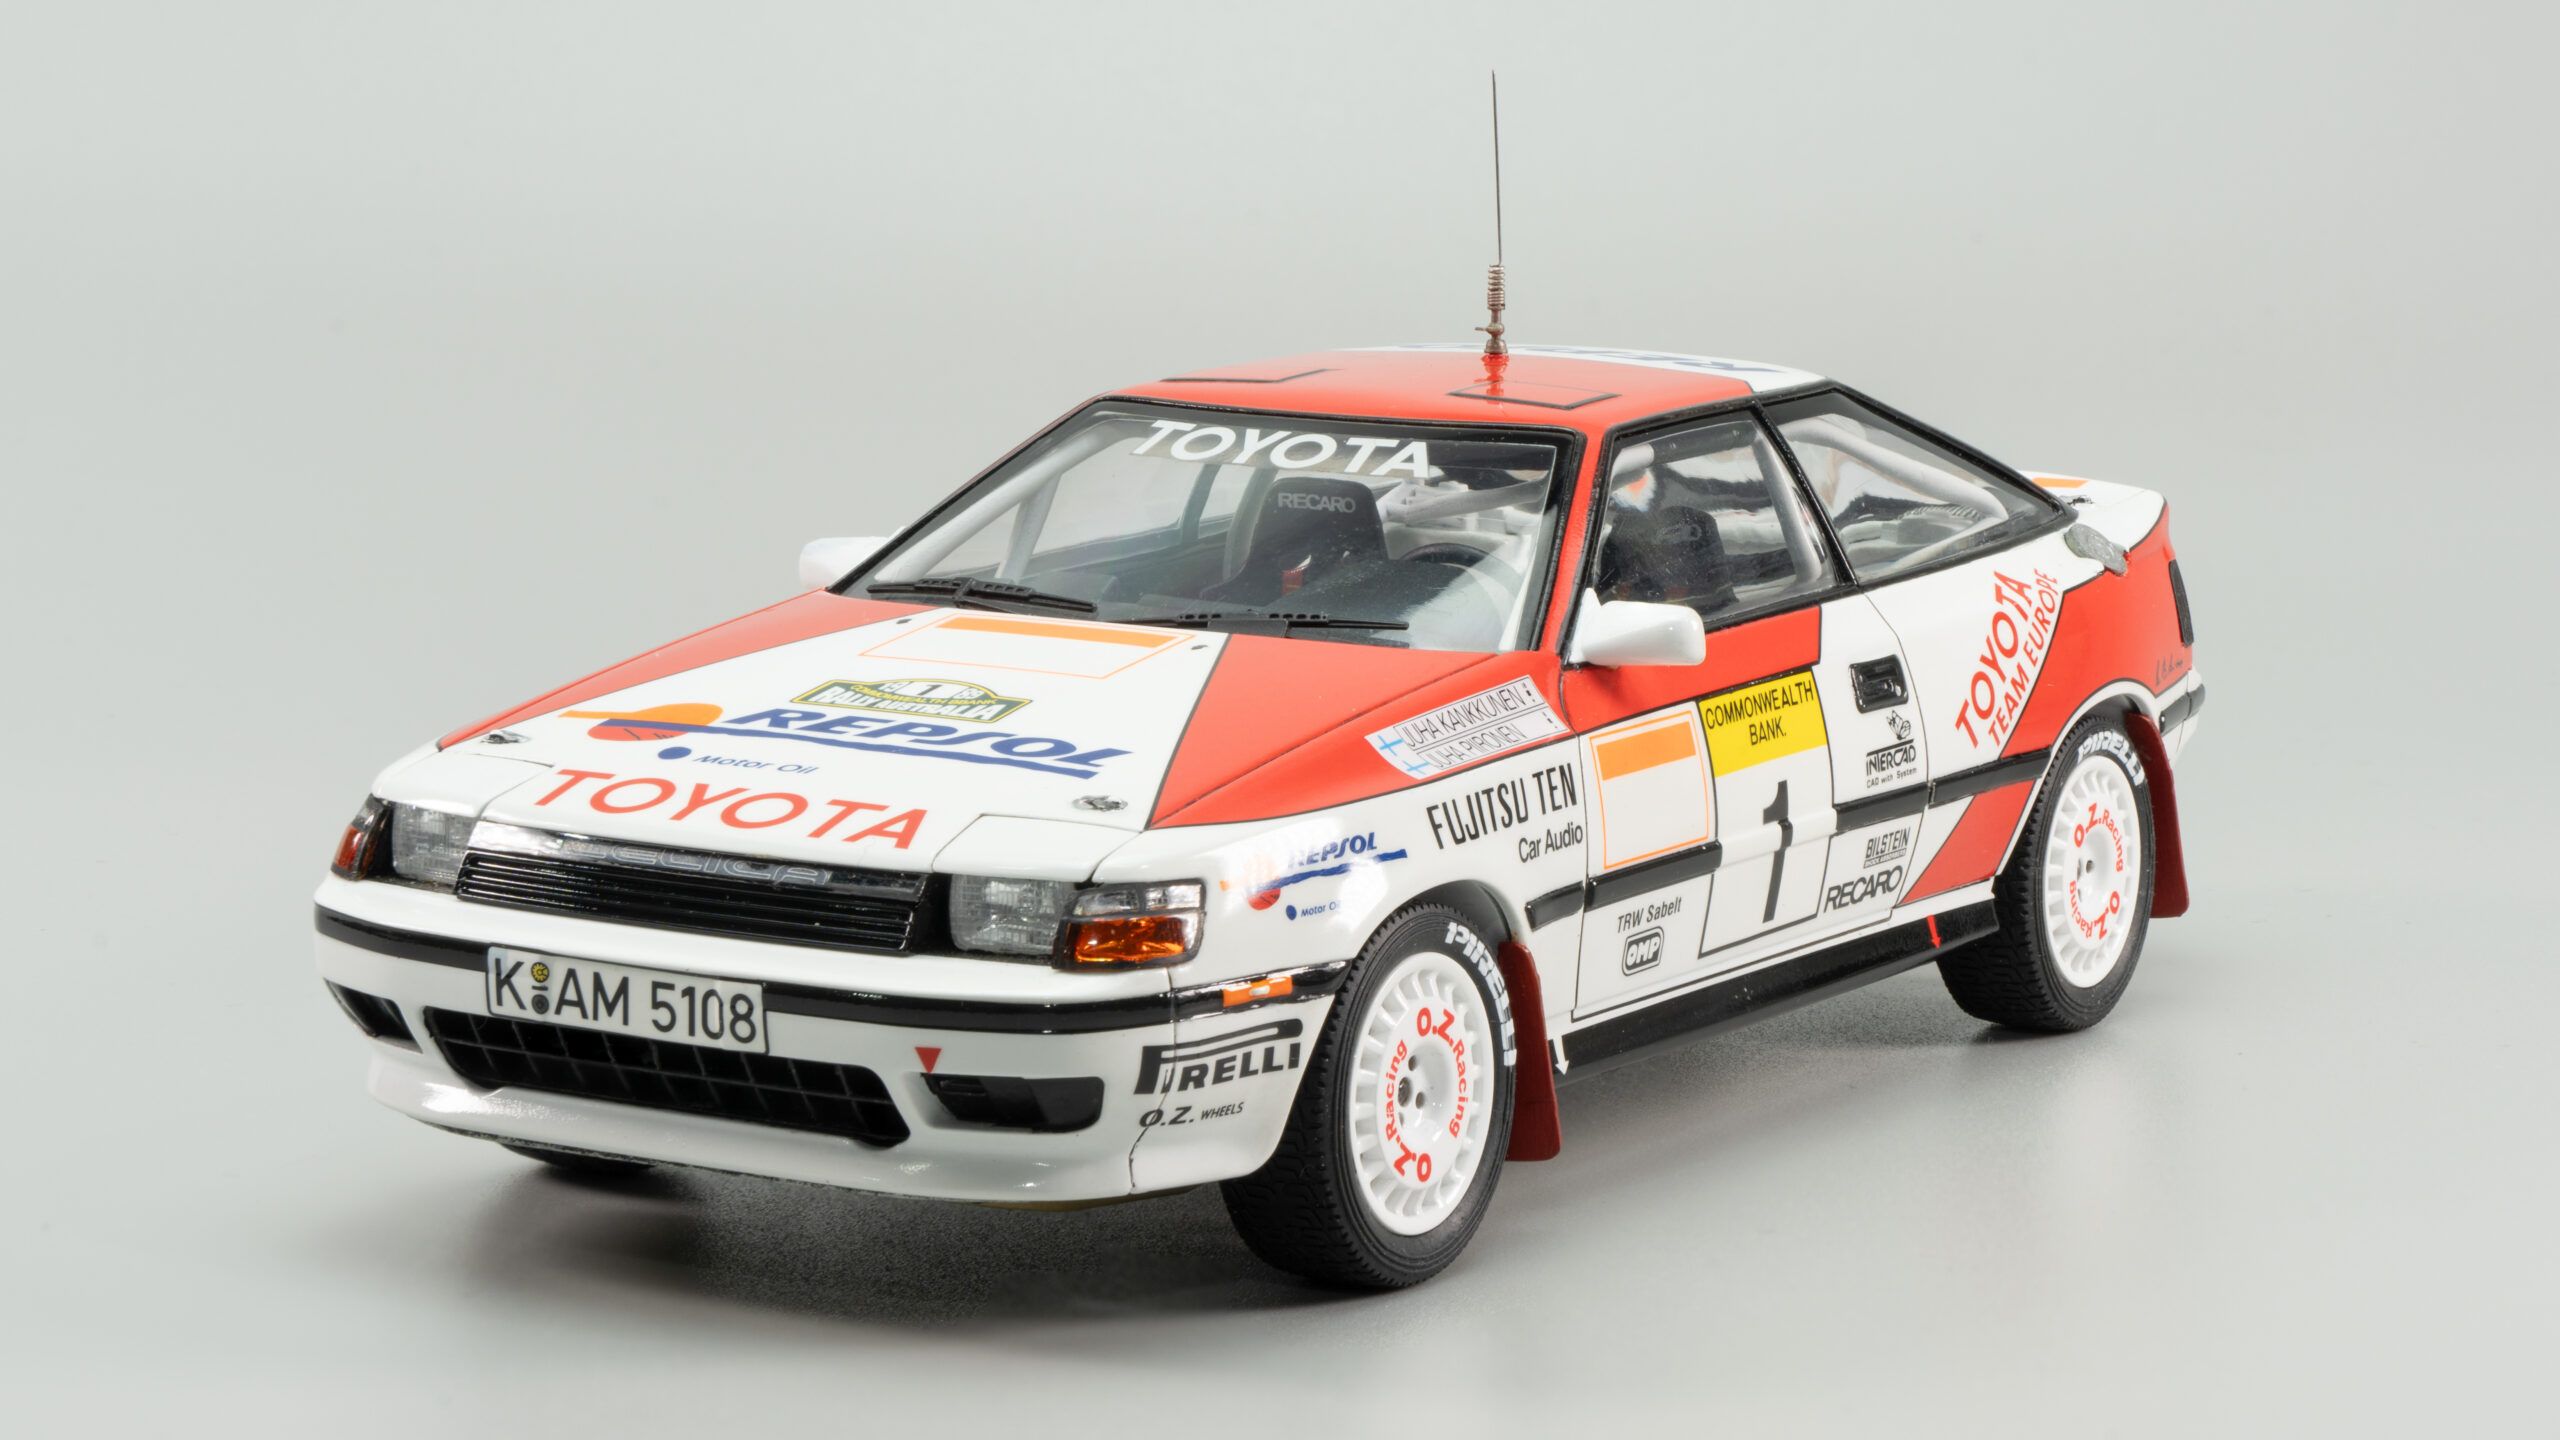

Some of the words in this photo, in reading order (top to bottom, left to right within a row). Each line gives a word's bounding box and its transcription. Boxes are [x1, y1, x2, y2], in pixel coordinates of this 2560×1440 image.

[1132, 420, 1430, 479] TOYOTA
[1277, 492, 1356, 514] RECARO
[1955, 571, 2032, 748] TOYOTA
[1988, 662, 2030, 746] TEAM
[2023, 568, 2059, 668] EUROPE
[807, 686, 878, 707] RALLY
[875, 700, 1007, 721] AUSTRALIA
[1401, 718, 1441, 748] JUHA
[1436, 686, 1527, 733] KANKKUNEN
[1705, 680, 1814, 730] COMMONWEALTH
[723, 708, 1132, 768] REPSOL
[1426, 742, 1465, 768] JUHA
[692, 755, 770, 770] Motor
[777, 763, 819, 775] Oil
[535, 768, 929, 850] TOYOTA
[1426, 778, 1529, 850] FUJITSU
[1532, 763, 1577, 815] TEN
[1518, 837, 1541, 863] Car
[1544, 822, 1583, 854] Audio
[1762, 780, 1793, 924] 1
[1865, 827, 1911, 859] BILSTEIN
[1824, 865, 1903, 913] RECARO
[1617, 908, 1644, 934] TRW
[1646, 896, 1682, 923] Sabelt
[1626, 936, 1661, 967] OMP
[651, 980, 757, 1044] 5108
[1133, 1018, 1303, 1095] PIRELLI
[1139, 1105, 1195, 1128] O.Z.
[1200, 1102, 1245, 1121] WHEELS
